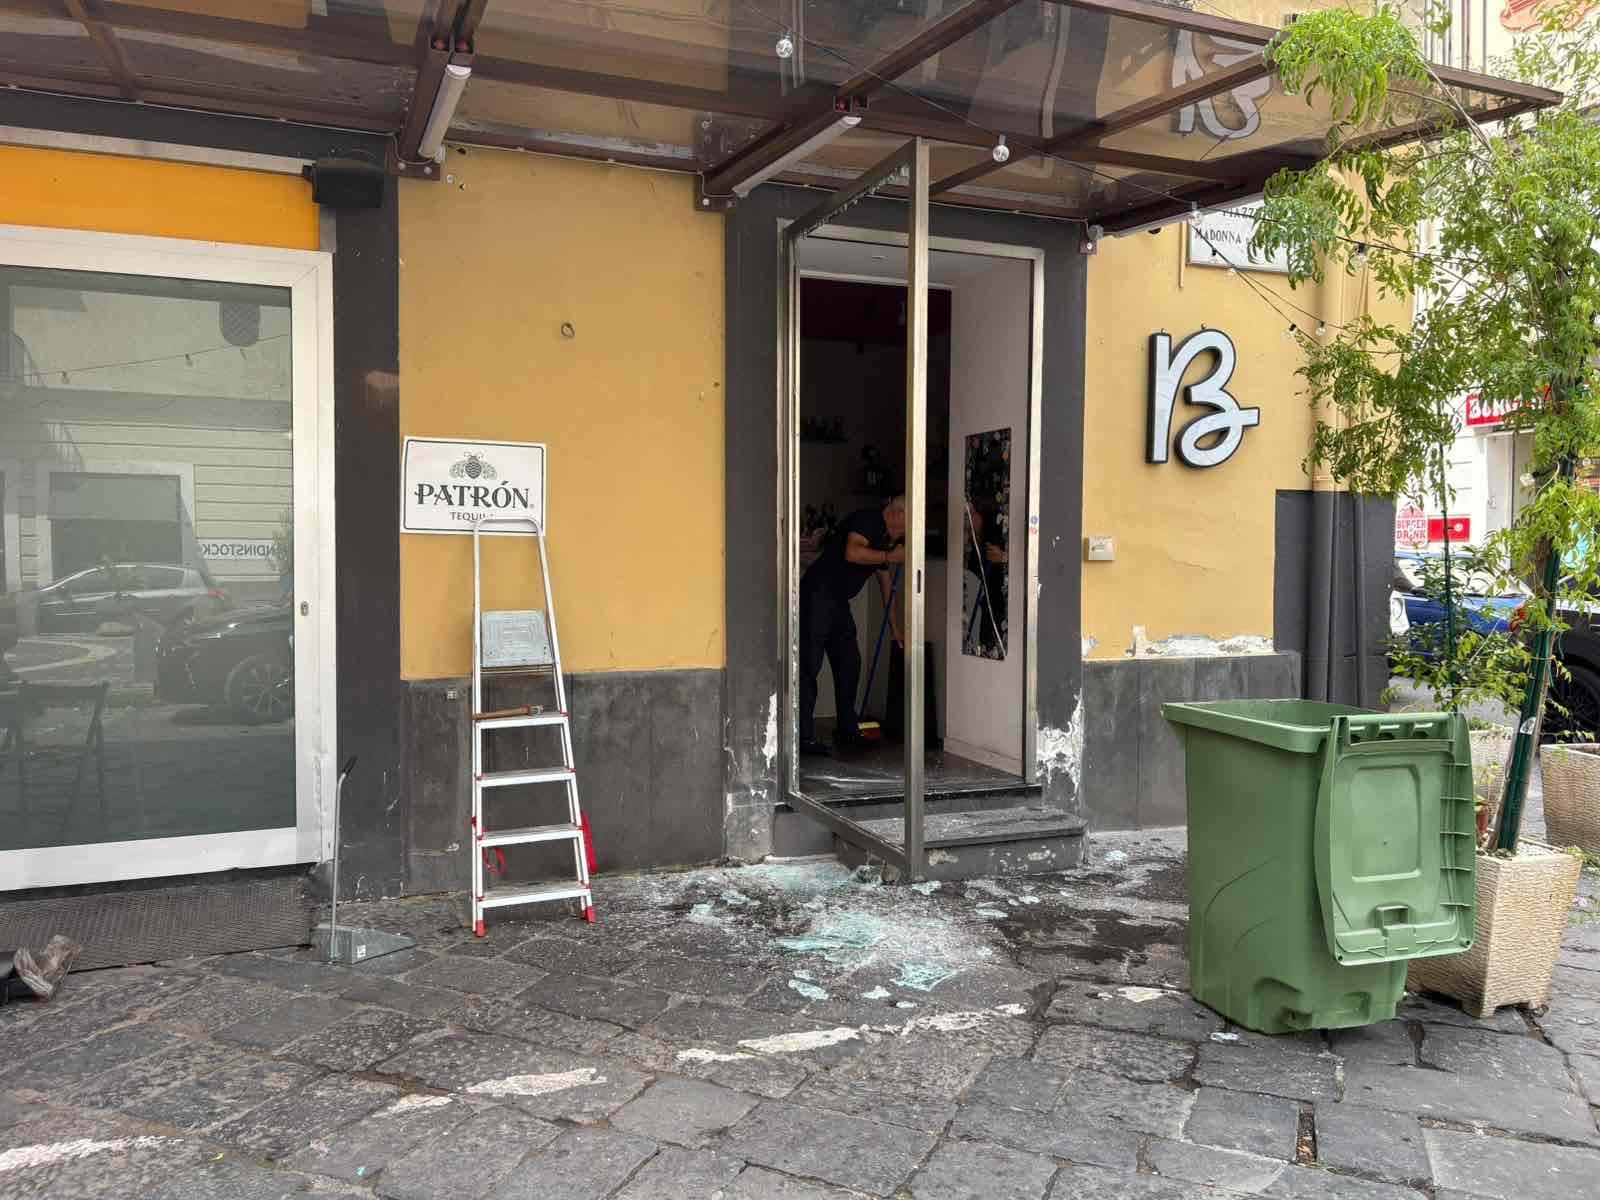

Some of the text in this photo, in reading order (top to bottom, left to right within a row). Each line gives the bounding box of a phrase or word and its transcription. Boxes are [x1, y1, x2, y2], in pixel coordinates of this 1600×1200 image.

[1195, 227, 1242, 245] MADONNA
[414, 481, 529, 509] PATRÓN
[450, 512, 495, 521] TEQUI
